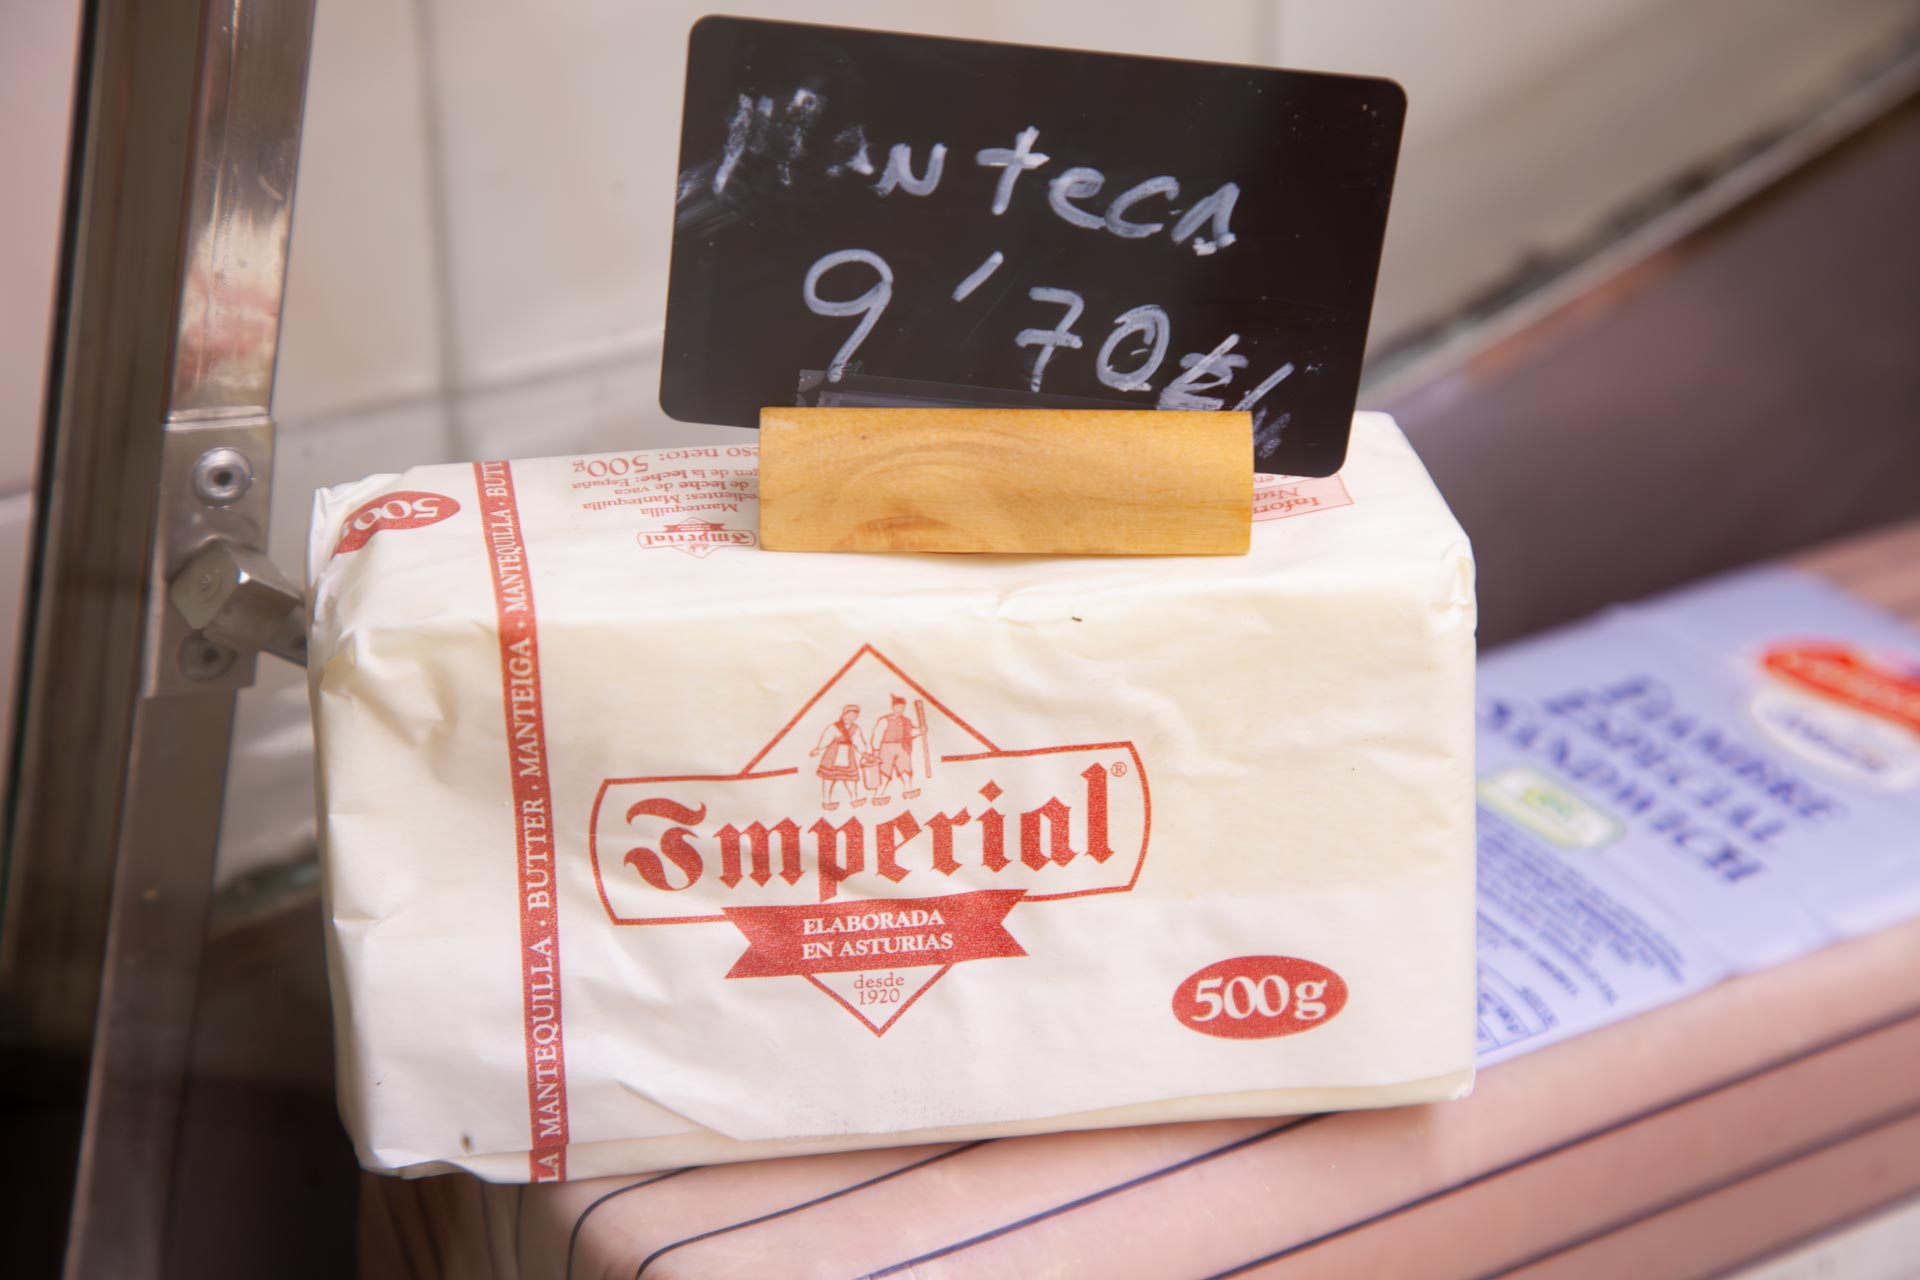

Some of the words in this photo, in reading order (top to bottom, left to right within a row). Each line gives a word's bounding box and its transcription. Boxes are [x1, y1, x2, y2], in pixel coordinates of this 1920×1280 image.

[659, 447, 718, 460] neto:
[572, 454, 649, 477] 500g
[711, 469, 729, 477] de
[481, 461, 508, 497] BUTT
[572, 478, 630, 490] España
[635, 469, 688, 482] leche:
[614, 487, 649, 495] vaca
[656, 482, 674, 491] de
[679, 480, 727, 491] leche
[730, 480, 749, 491] de
[583, 494, 680, 511] Mantequilla
[640, 503, 739, 517] Mantequilla
[490, 509, 528, 613] MANTEQUILLA
[509, 636, 541, 778] MANTEIGA
[523, 798, 550, 910] BUTTER
[802, 909, 945, 936] ELABORADA
[801, 941, 833, 960] EN
[839, 933, 954, 957] ASTURIAS
[853, 972, 905, 989] desde
[858, 989, 900, 1006] 1920
[1191, 974, 1328, 1022] 500g
[530, 936, 563, 1138] MANTEQUILLA
